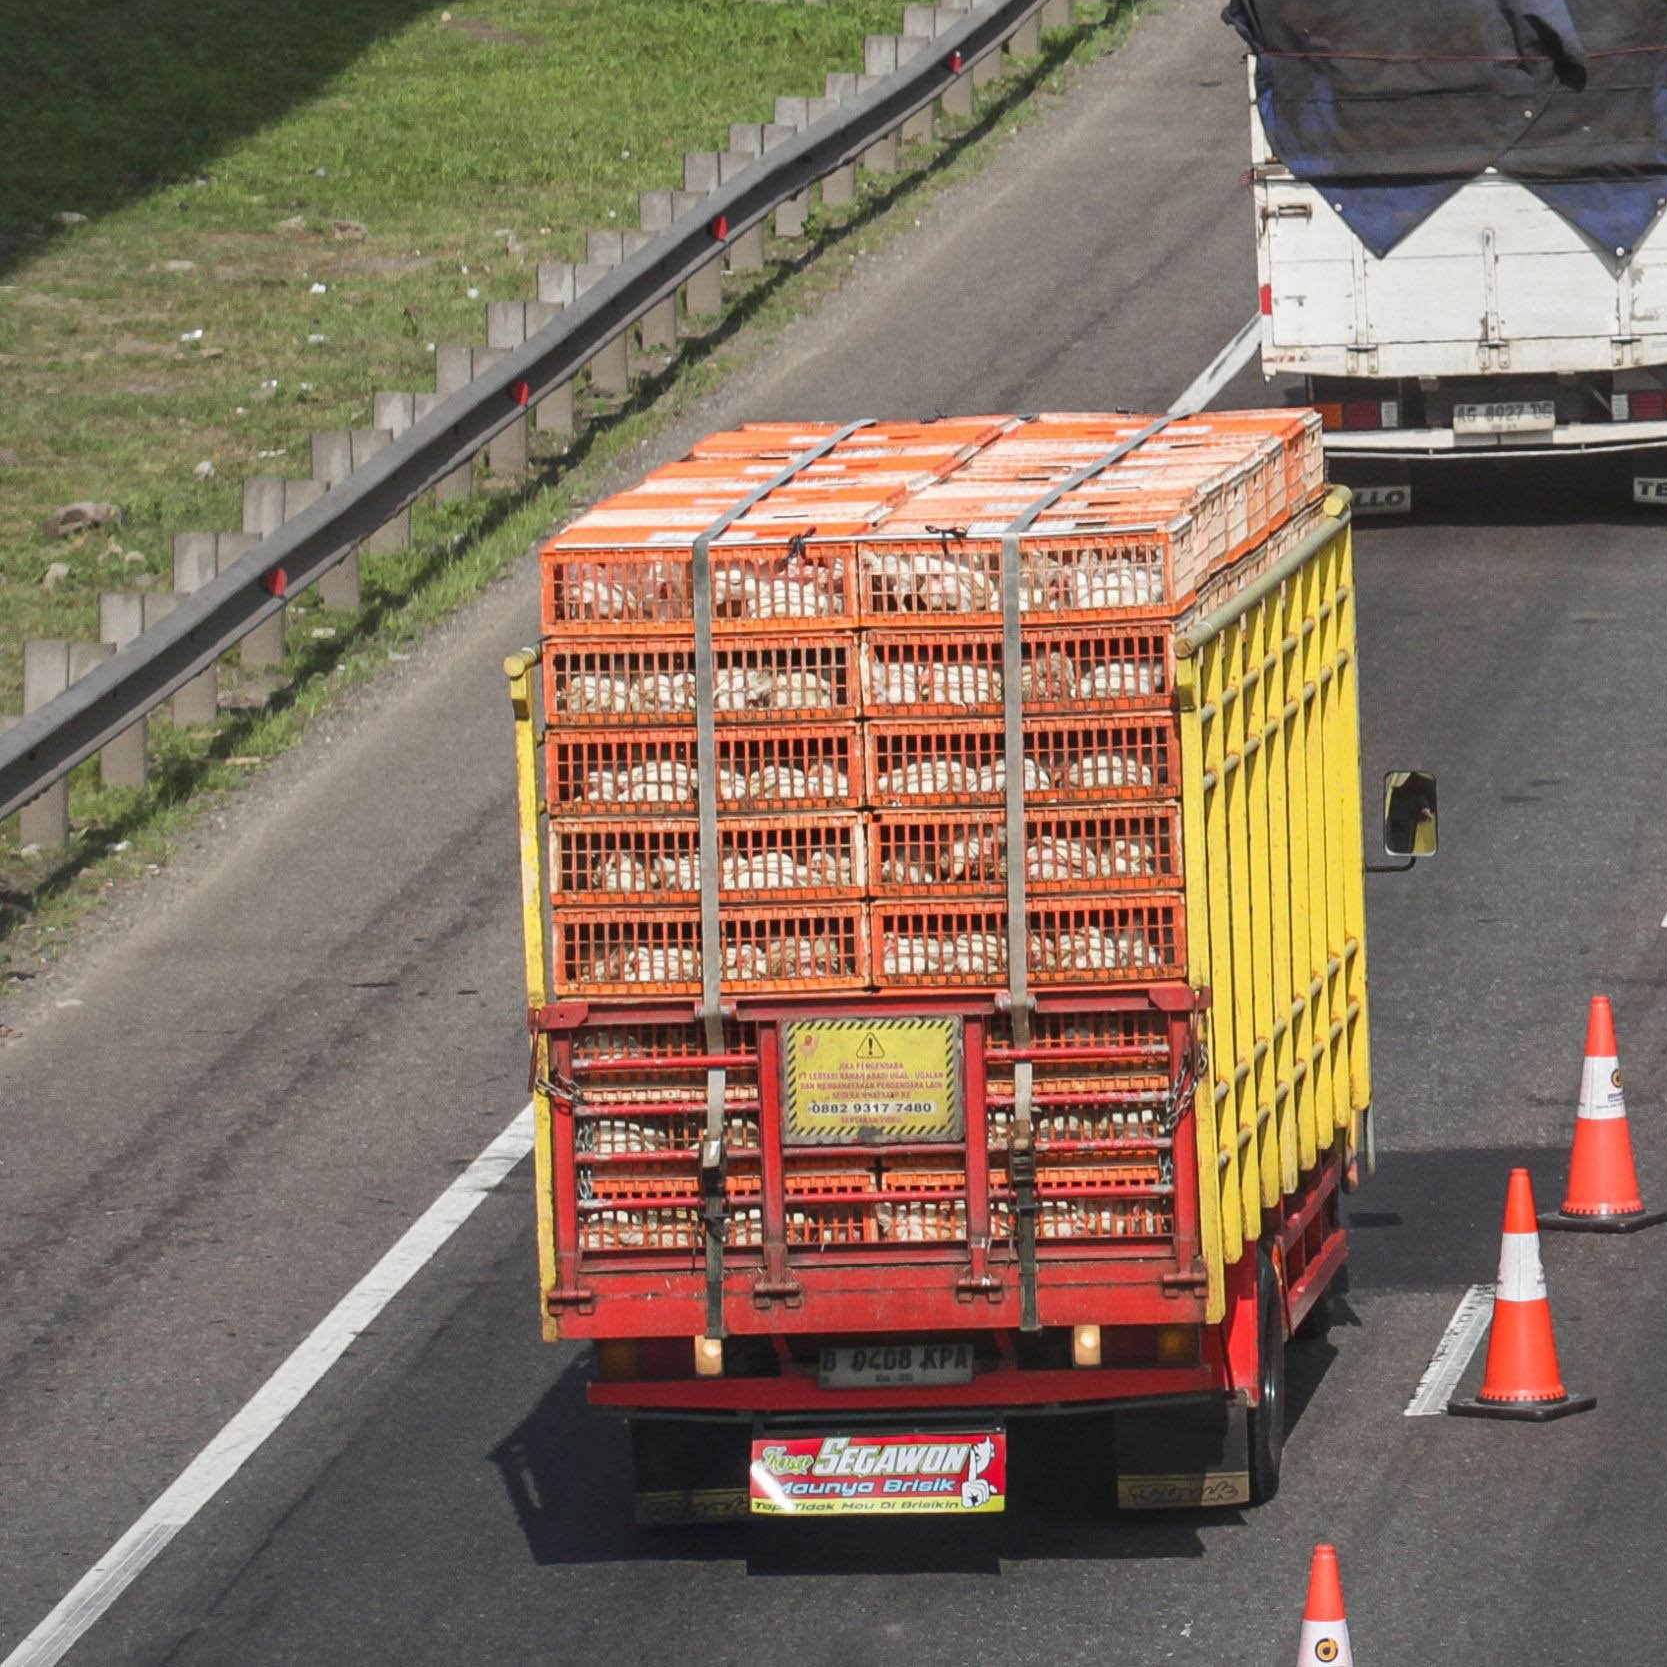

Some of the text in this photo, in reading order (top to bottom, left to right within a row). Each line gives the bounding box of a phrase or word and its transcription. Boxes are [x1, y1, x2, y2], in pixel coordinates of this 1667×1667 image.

[811, 1102, 932, 1114] 0882 9317 7480
[919, 1346, 968, 1372] KPA
[812, 1437, 972, 1479] SEGAWON
[753, 1501, 785, 1512] Tap
